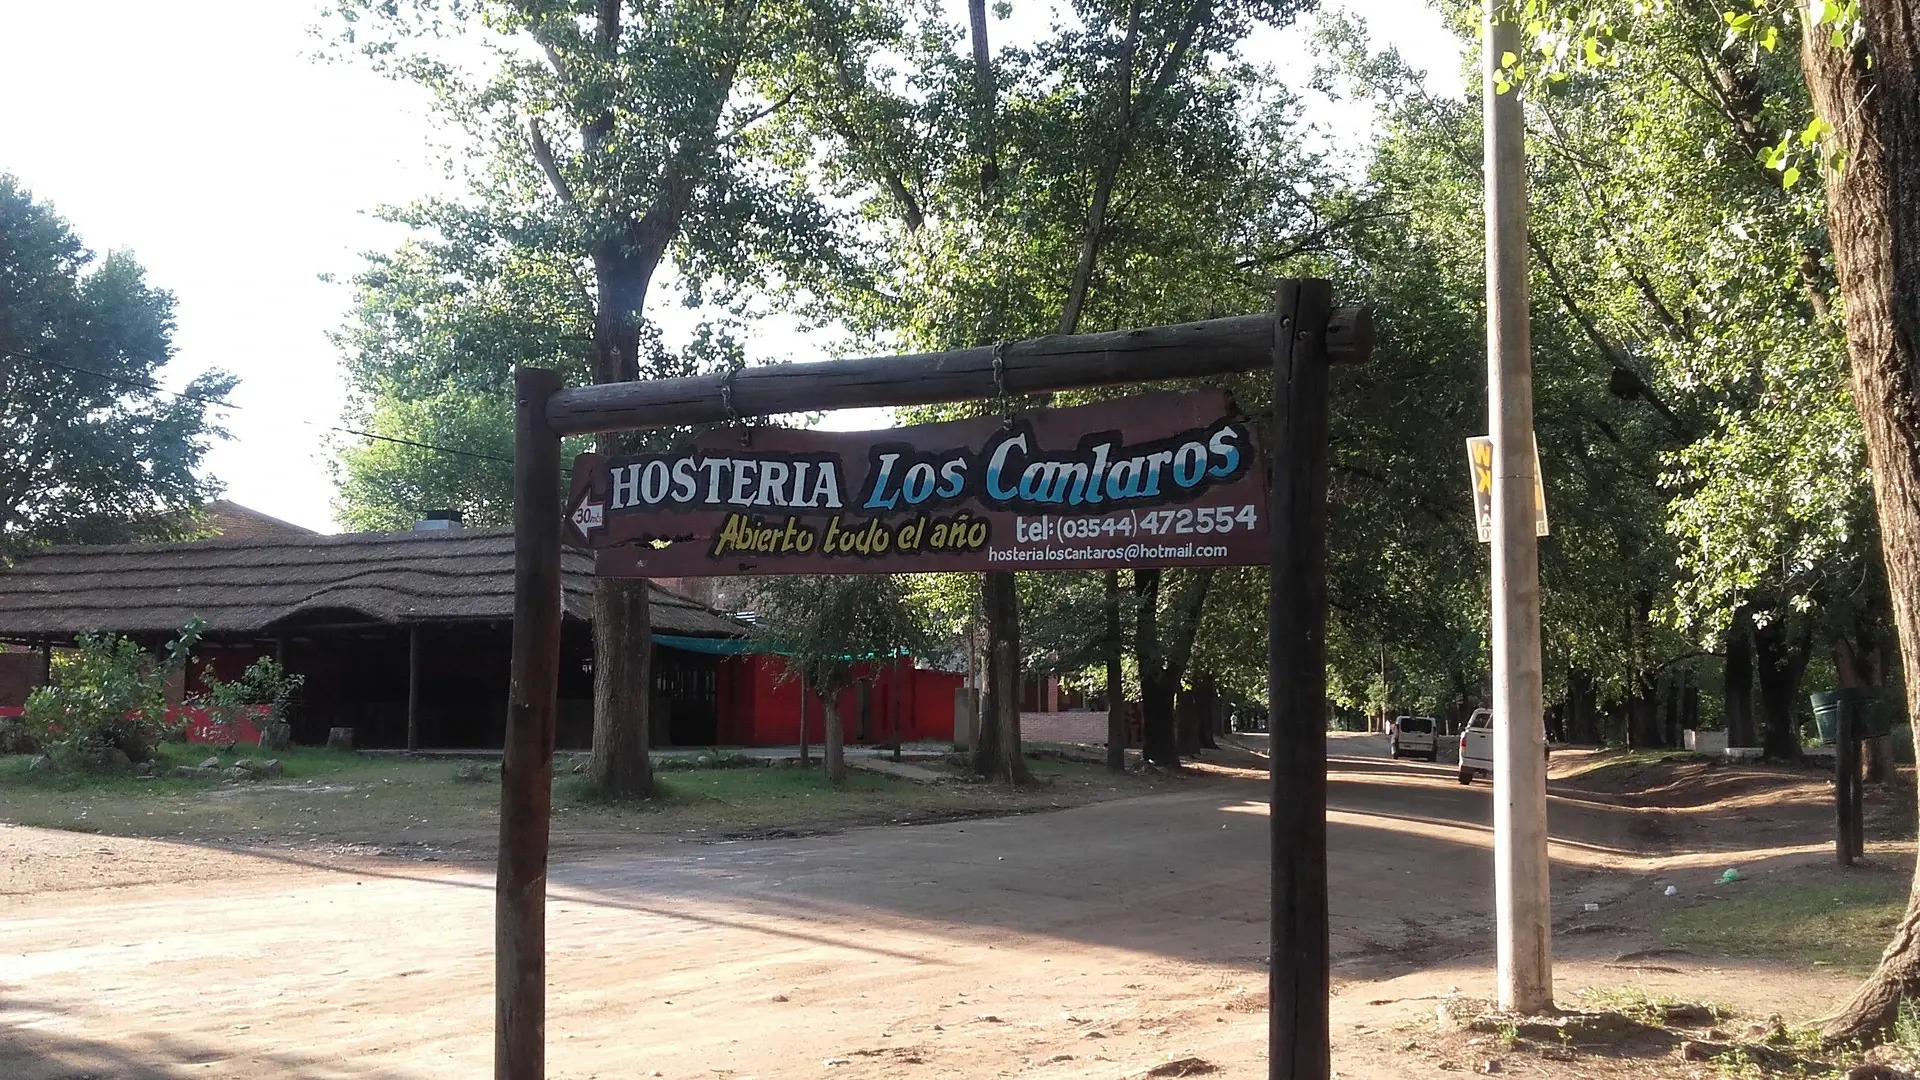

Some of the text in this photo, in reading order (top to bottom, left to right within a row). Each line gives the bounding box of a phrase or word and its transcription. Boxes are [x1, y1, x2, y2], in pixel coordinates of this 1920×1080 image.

[610, 425, 1240, 510] HOSTERIA Los Cantaros
[714, 513, 987, 556] Abierto todo el año
[1016, 504, 1257, 544] tel: (03544) 472554
